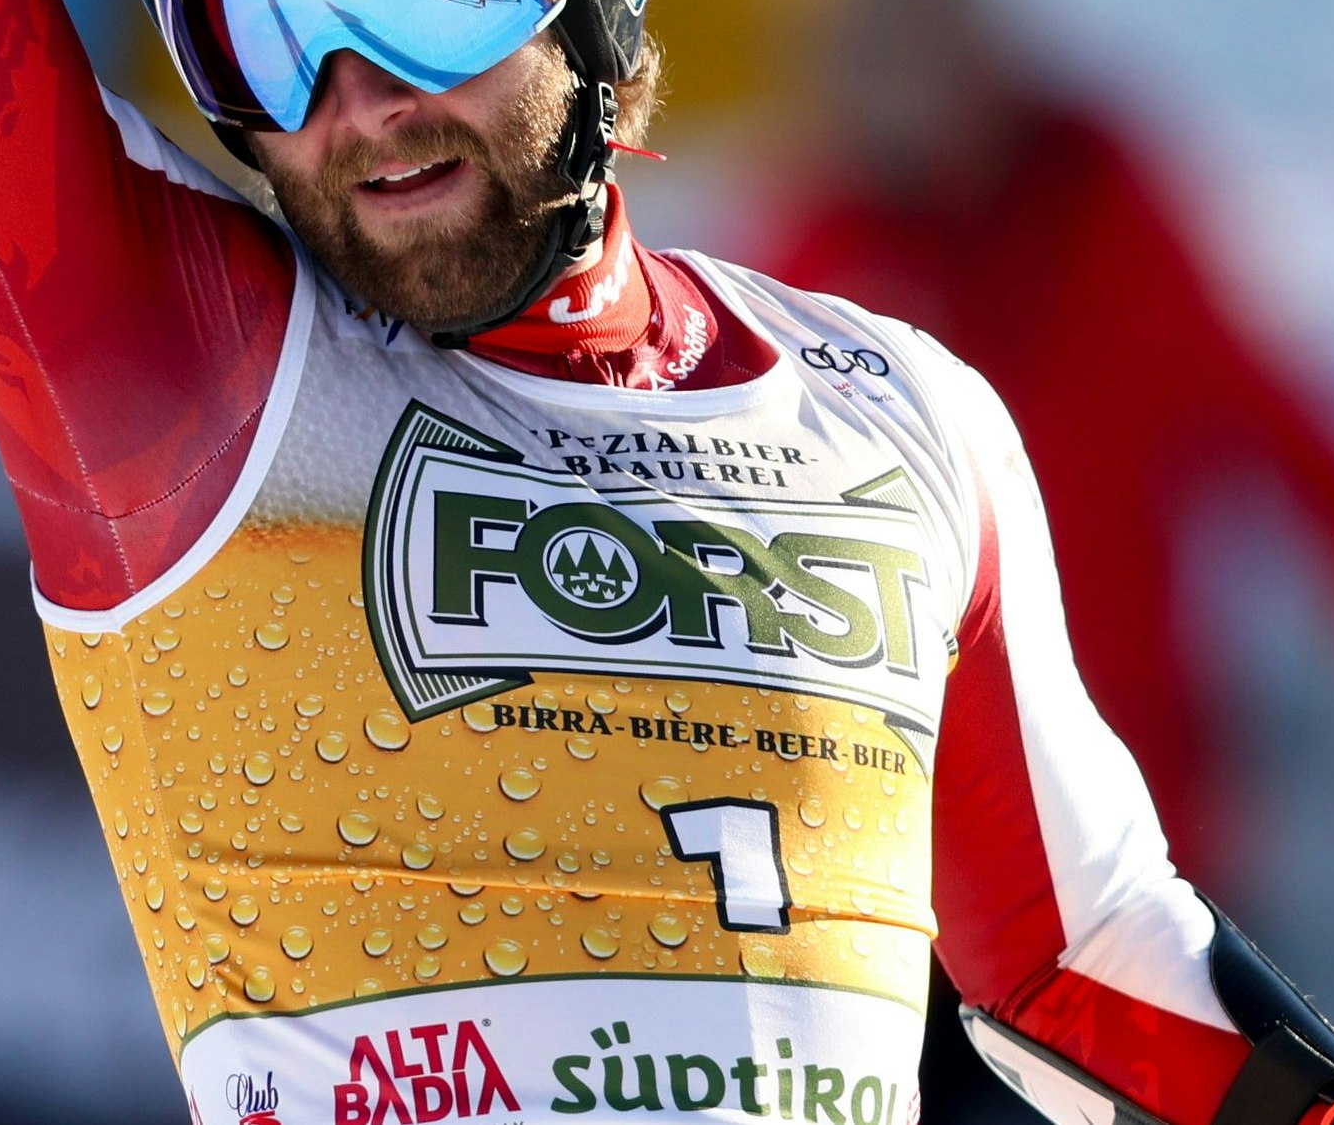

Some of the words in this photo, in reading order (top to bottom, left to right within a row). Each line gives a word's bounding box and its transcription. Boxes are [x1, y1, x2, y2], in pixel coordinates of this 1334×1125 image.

[668, 303, 708, 380] Schöffel
[563, 455, 788, 487] BRAUEREI
[429, 489, 929, 681] FORST
[658, 796, 791, 935] 1
[349, 1019, 490, 1083] ALTA
[226, 1071, 279, 1118] Club
[333, 1068, 522, 1125] BADIA
